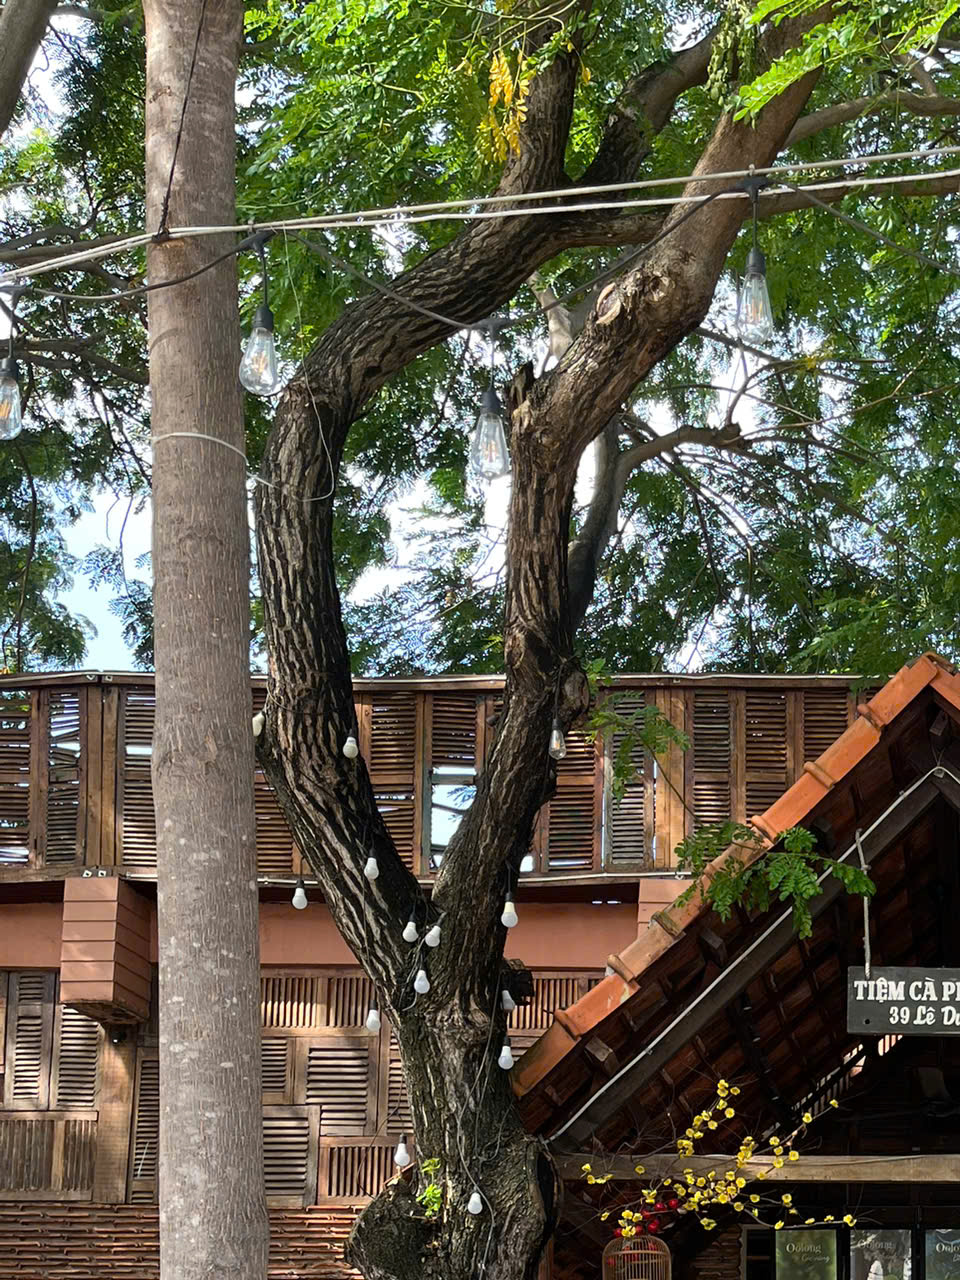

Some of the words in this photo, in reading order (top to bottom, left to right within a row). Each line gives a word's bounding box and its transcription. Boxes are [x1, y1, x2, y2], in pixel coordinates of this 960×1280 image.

[853, 977, 905, 1003] TIỆM
[909, 976, 938, 1001] CÀ
[889, 1006, 910, 1025] 39
[913, 1005, 936, 1025] Lê
[785, 1243, 822, 1254] Oolong
